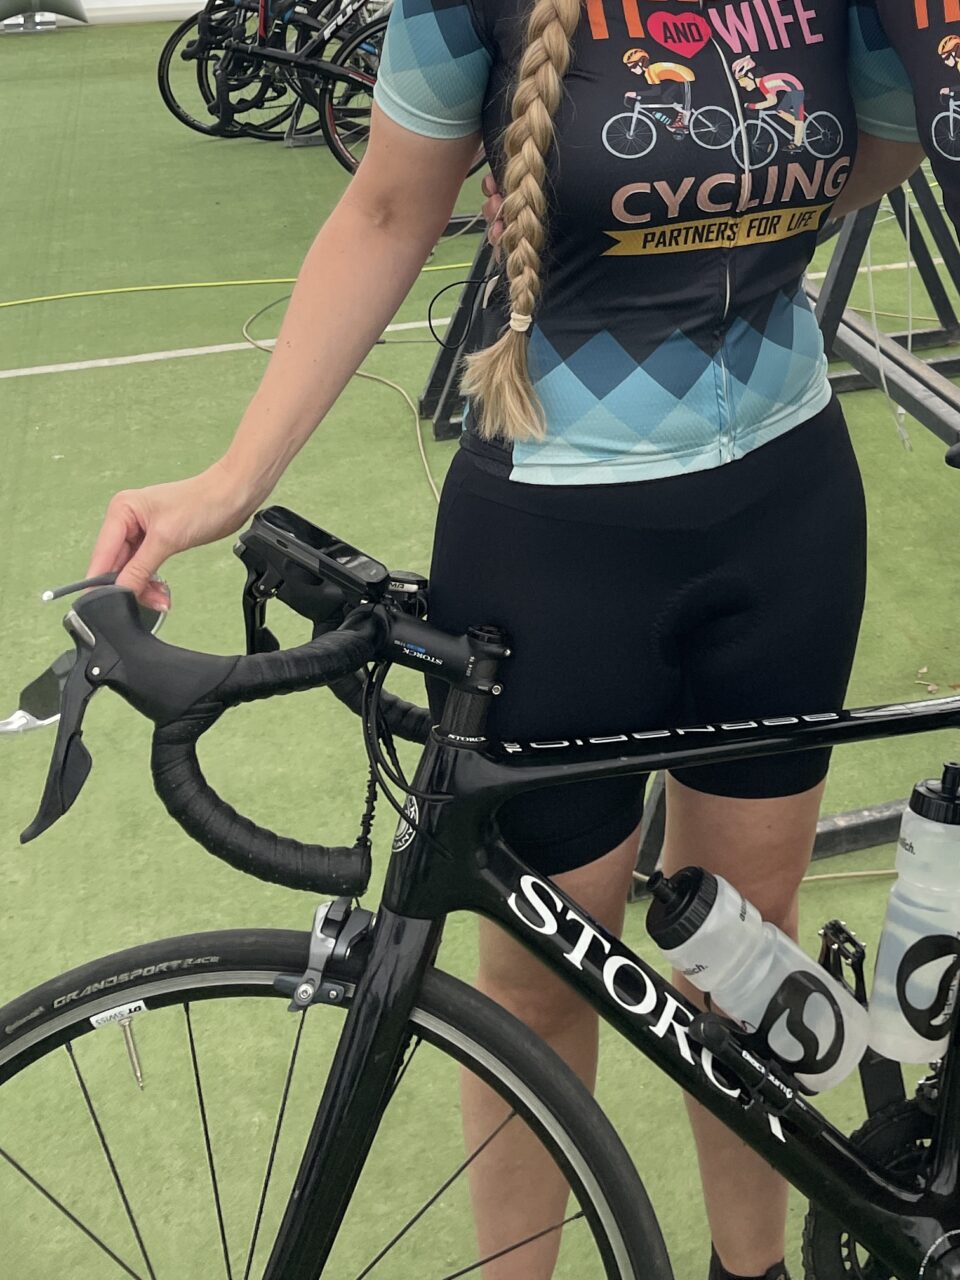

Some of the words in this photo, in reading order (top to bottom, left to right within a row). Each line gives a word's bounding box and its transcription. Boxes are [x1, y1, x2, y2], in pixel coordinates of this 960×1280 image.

[662, 20, 704, 45] AND
[611, 156, 850, 224] CYCLING
[642, 222, 739, 249] PARTNERS
[746, 215, 779, 238] FOR
[787, 209, 817, 232] LIFE
[402, 647, 443, 665] STORCK
[95, 1011, 126, 1026] SWISS
[128, 1005, 142, 1014] DT
